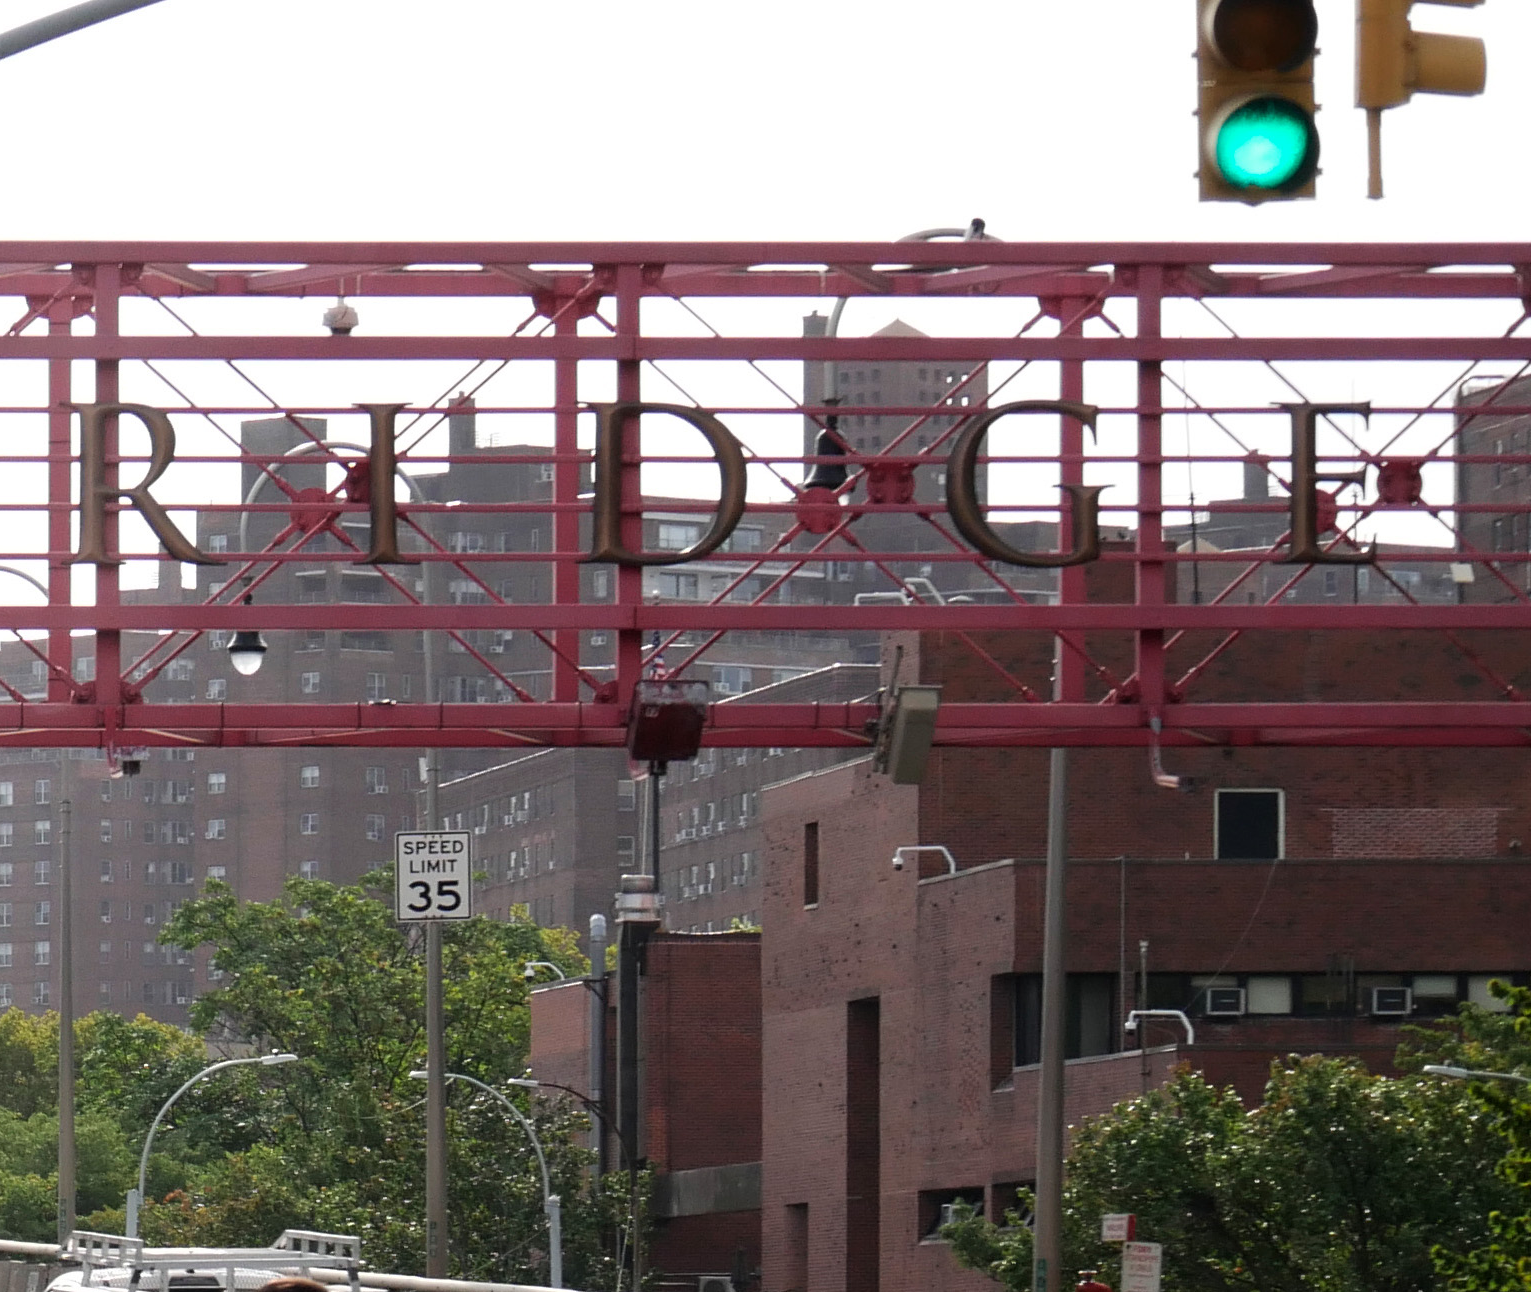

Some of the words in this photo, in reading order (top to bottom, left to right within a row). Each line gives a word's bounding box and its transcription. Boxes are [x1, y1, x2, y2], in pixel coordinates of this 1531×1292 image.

[403, 840, 464, 855] SPEED
[410, 859, 457, 873] LIMIT
[407, 880, 462, 912] 35
